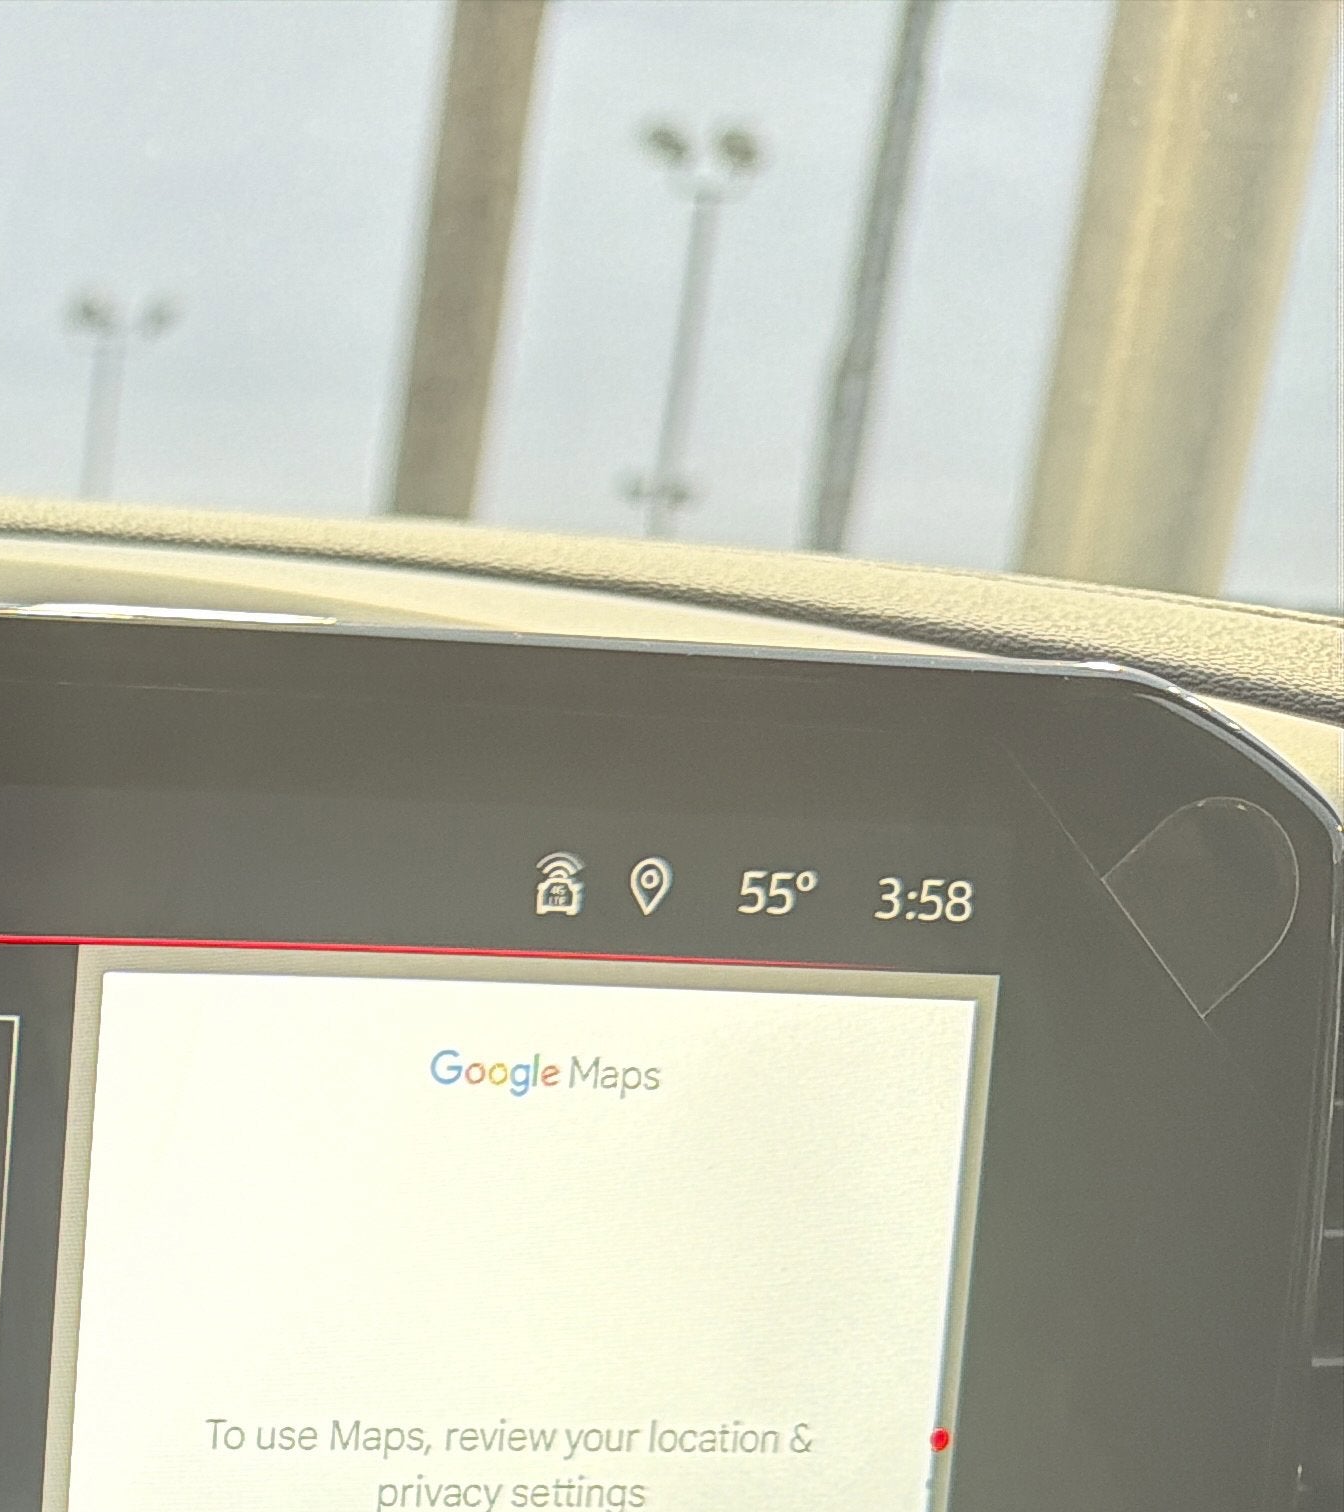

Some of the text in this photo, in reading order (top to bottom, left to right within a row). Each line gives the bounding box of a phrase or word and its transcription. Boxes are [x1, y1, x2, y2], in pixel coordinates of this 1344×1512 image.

[873, 877, 974, 922] 3:58
[430, 1049, 662, 1100] Google Maps
[205, 1417, 813, 1460] To use Maps, review your location &
